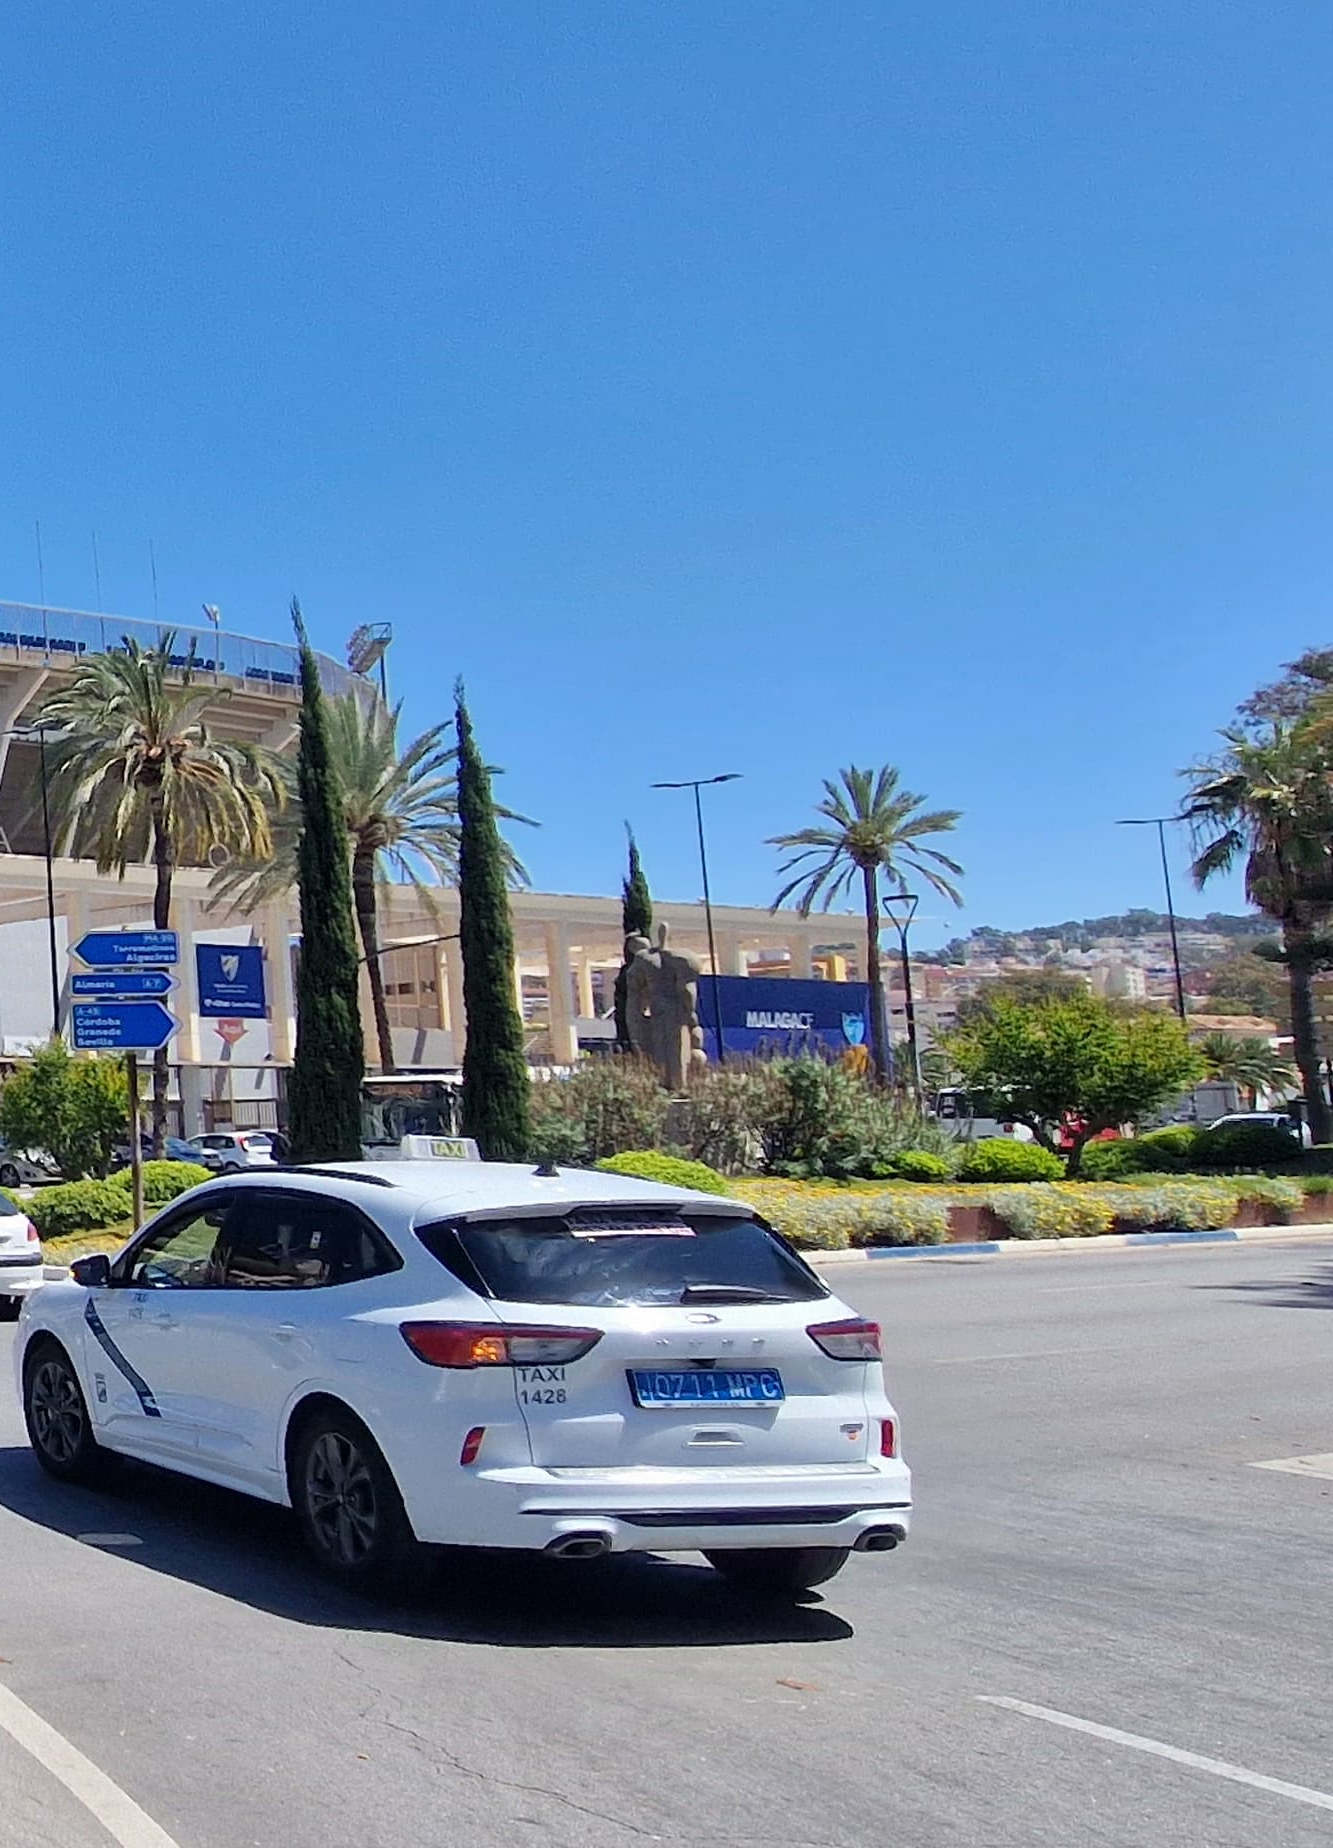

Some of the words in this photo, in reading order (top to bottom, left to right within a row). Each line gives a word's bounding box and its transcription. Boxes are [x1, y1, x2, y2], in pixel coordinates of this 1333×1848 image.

[77, 1028, 122, 1037] Granada
[435, 1141, 465, 1158] TAXI
[518, 1366, 566, 1383] TAXI
[520, 1388, 567, 1405] 1428
